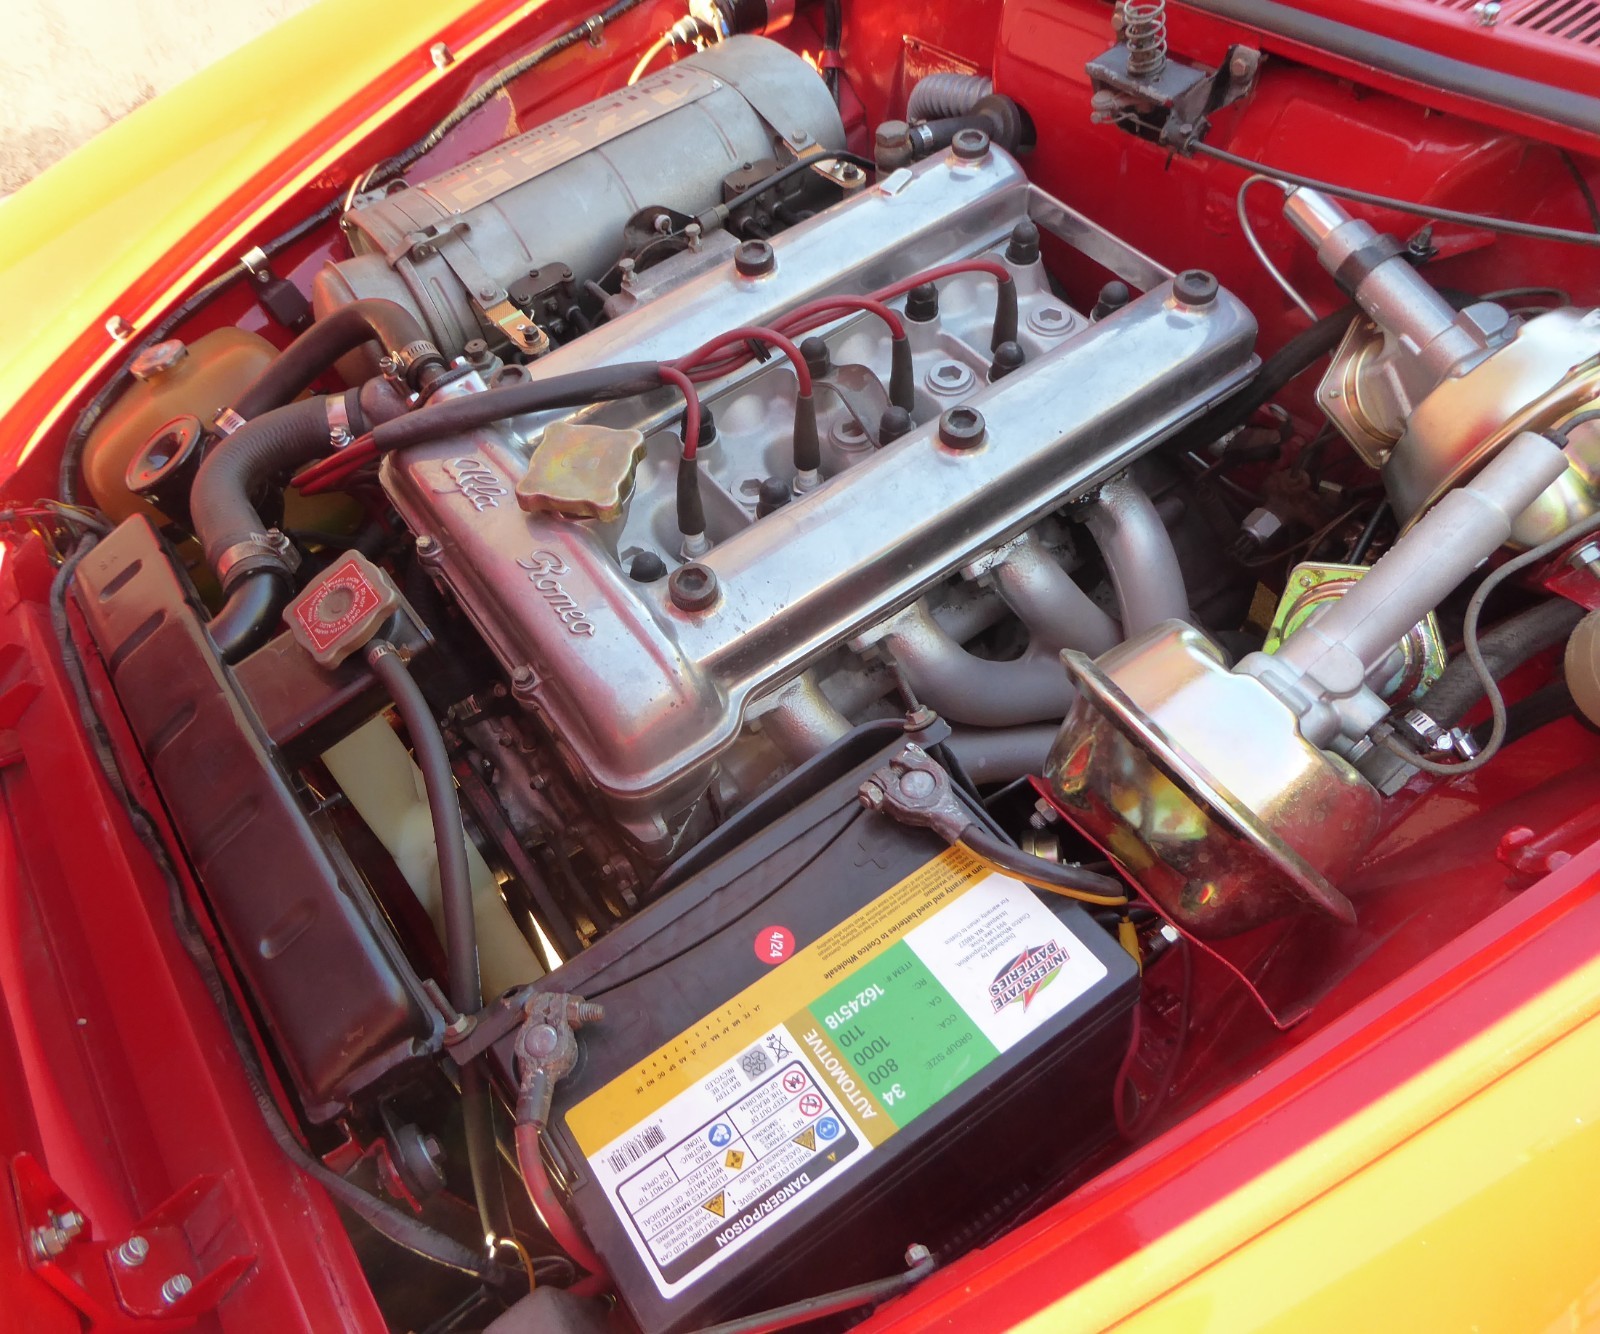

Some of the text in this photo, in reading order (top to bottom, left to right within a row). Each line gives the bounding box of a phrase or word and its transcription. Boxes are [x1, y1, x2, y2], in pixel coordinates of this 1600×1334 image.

[452, 83, 699, 202] 1750
[433, 457, 508, 512] Alfa
[516, 551, 595, 636] Romeo
[330, 623, 347, 634] WHEN
[944, 871, 974, 894] warranty
[915, 900, 933, 916] used
[931, 891, 946, 904] and
[887, 911, 918, 934] batteries
[1011, 912, 1031, 927] Costco
[879, 932, 889, 940] to
[973, 927, 985, 936] WA
[983, 927, 997, 938] Lake
[986, 925, 1013, 946] Wholesale
[769, 931, 784, 957] 4/24
[856, 937, 882, 956] Costco
[980, 932, 1017, 959] Distributed by
[823, 953, 859, 980] Wholesale
[891, 960, 913, 978] ITEM
[987, 941, 1060, 996] BATTERIES
[914, 977, 928, 989] RC:
[989, 948, 1071, 1010] INTERSTATE
[824, 983, 885, 1030] 1624518
[928, 995, 942, 1008] CA:
[936, 1013, 957, 1029] CCA:
[765, 1033, 776, 1041] Pb
[838, 1024, 865, 1048] 110
[853, 1035, 890, 1066] 1000
[925, 1032, 973, 1070] GROUP SIZE:
[704, 1066, 735, 1091] RECYCLED
[802, 1027, 878, 1119] AUTOMOTIVE
[867, 1058, 899, 1085] 800
[711, 1074, 737, 1095] MUST BE
[715, 1080, 741, 1102] BATTERY
[770, 1081, 778, 1090] OF
[881, 1082, 906, 1106] 34
[749, 1088, 783, 1115] THE REACH
[750, 1094, 788, 1125] KEEP OUT OF
[751, 1120, 779, 1141] SMOKING
[759, 1125, 783, 1144] FLAMES
[763, 1117, 805, 1150] NO SPARKS
[694, 1149, 712, 1164] READ
[702, 1158, 719, 1174] HELP
[751, 1146, 802, 1185] GASES CAN CAUSE
[788, 1149, 812, 1170] SHIELD
[658, 1169, 669, 1180] OR
[706, 1166, 723, 1181] WITH
[638, 1176, 674, 1206] DO NOT TIP
[670, 1195, 684, 1207] GET
[738, 1178, 772, 1207] EXPLOSIVE
[651, 1173, 728, 1233] FLUSH EYES IMMEDIATELY
[715, 1172, 810, 1247] DANGER/POISON
[642, 1204, 670, 1227] MEDICAL
[674, 1214, 695, 1232] SEVERE
[659, 1217, 719, 1263] SULFURIC ACID CAN
[663, 1212, 711, 1250] CAUSE BLINDNESS
